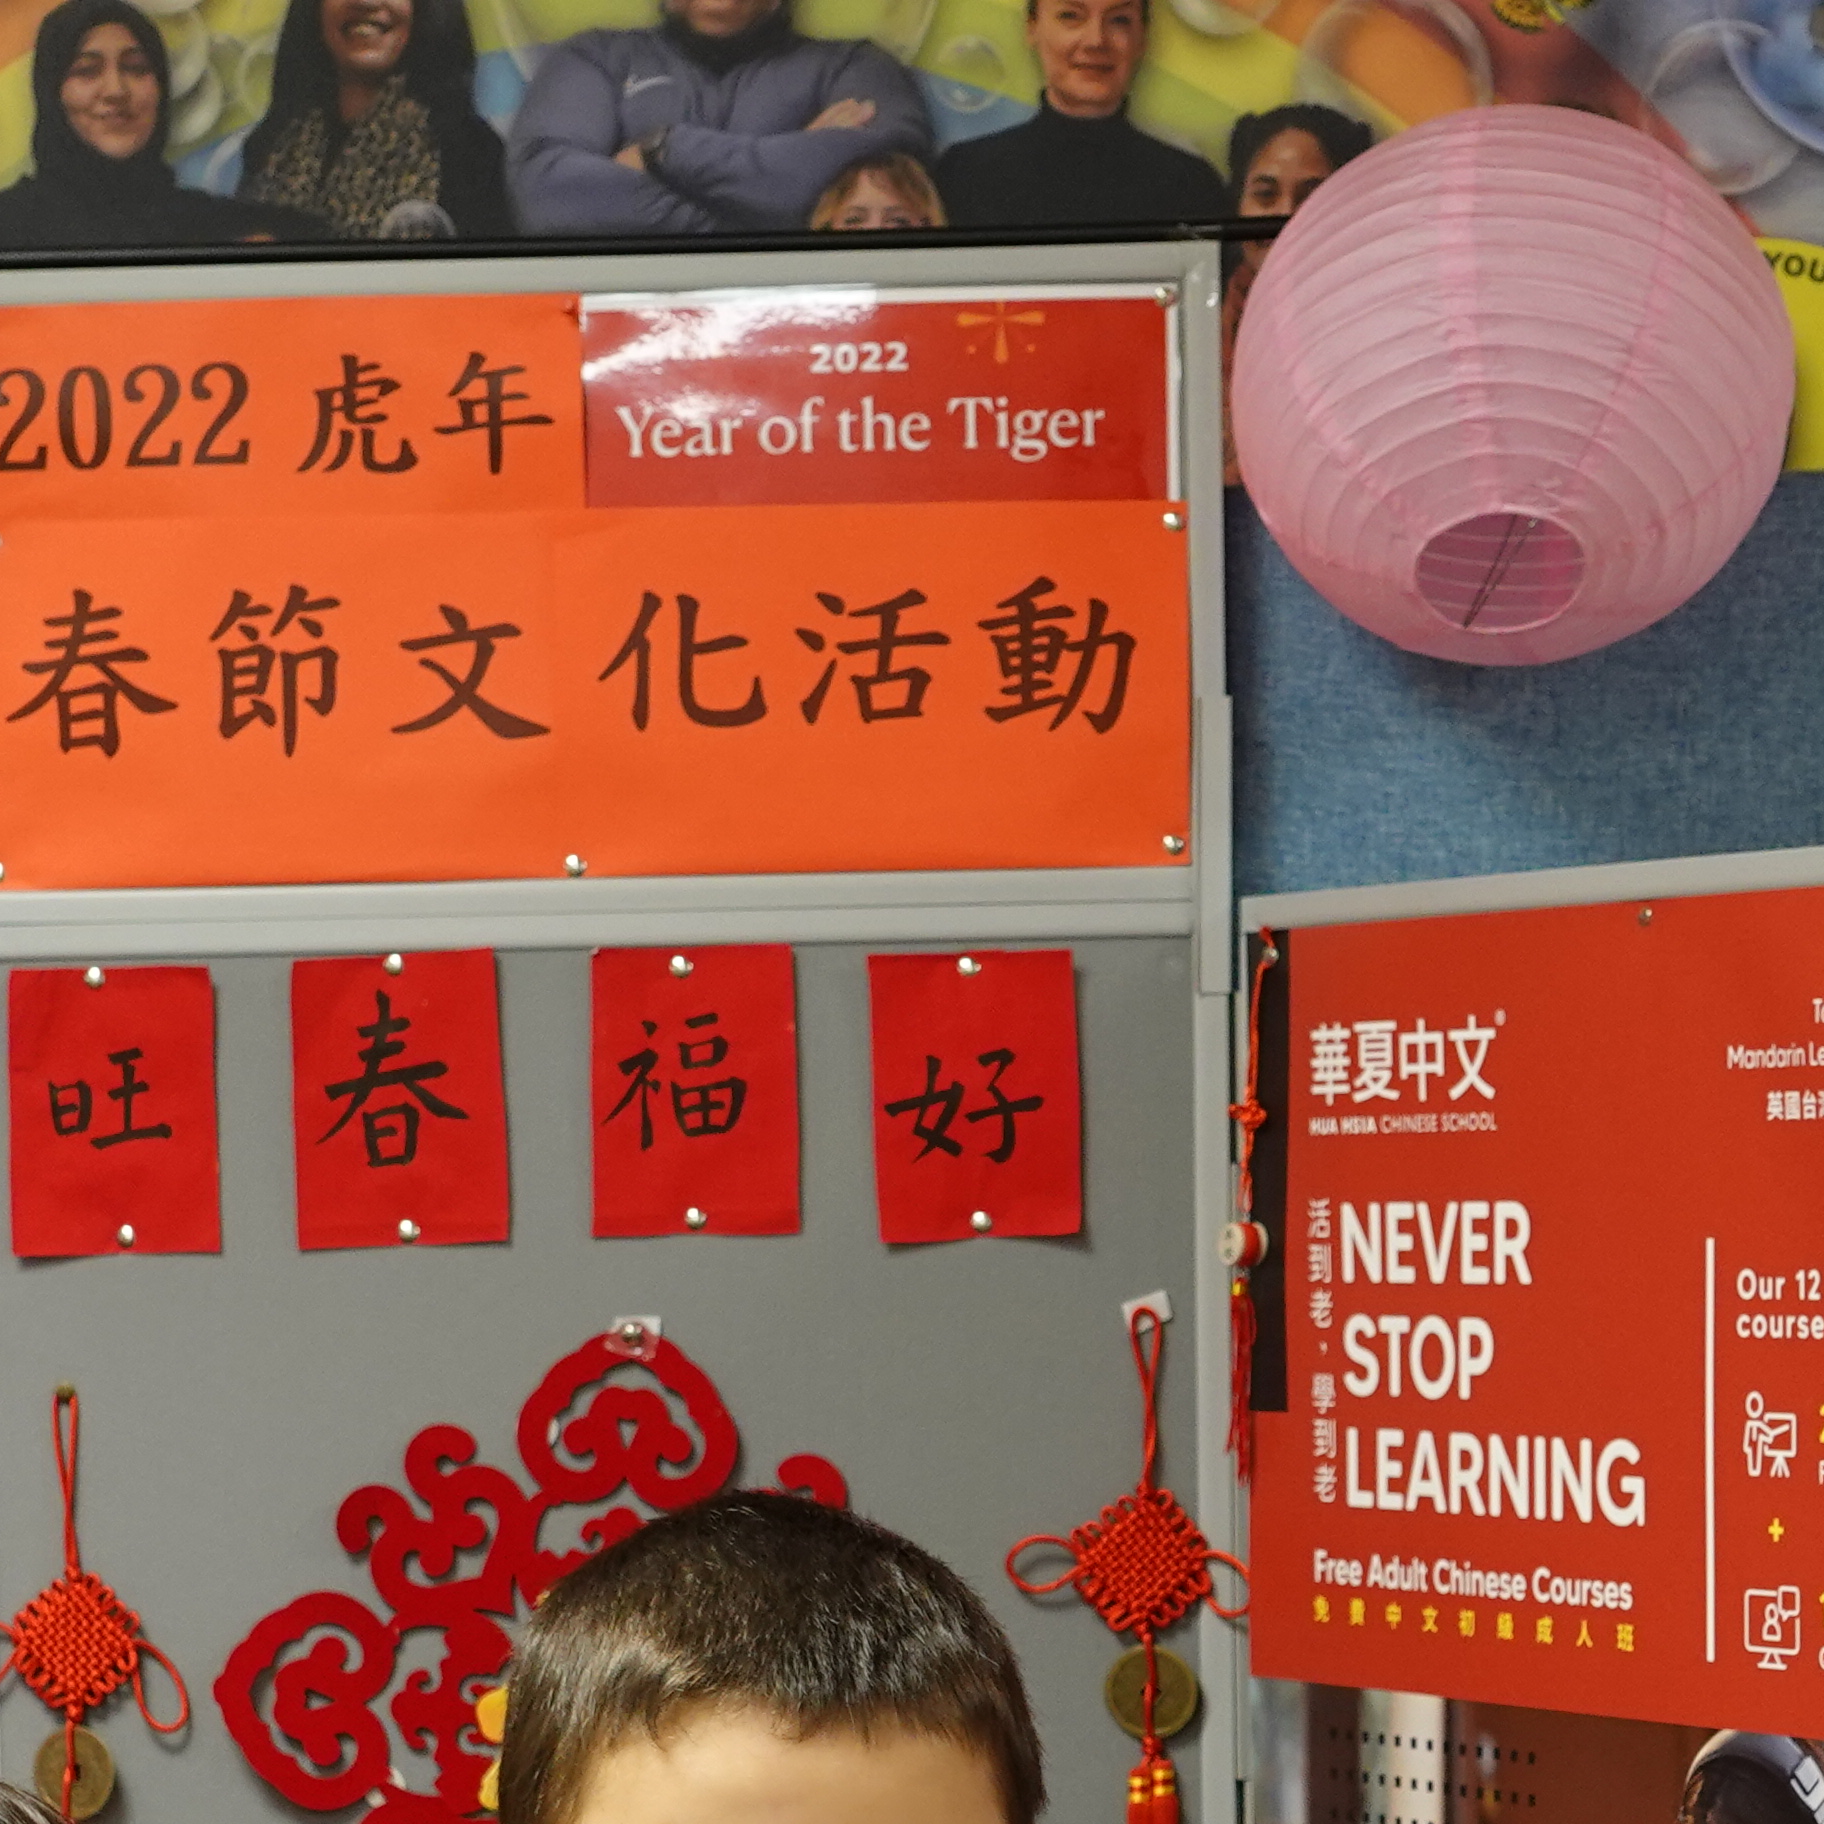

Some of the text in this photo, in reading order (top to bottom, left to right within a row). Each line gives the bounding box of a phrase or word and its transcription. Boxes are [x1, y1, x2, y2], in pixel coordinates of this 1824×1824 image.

[809, 341, 909, 373] 2022
[295, 350, 554, 476] 虎年
[615, 396, 1105, 463] Year of the Tiger
[5, 576, 1136, 760] 春節文化活動
[49, 1047, 172, 1151] 旺
[316, 990, 470, 1169] 春
[601, 1012, 748, 1150] 福
[1310, 1013, 1496, 1106] 華夏中文
[1727, 1044, 1806, 1070] Mandarin
[883, 1047, 1044, 1164] 好
[1309, 1111, 1498, 1136] HUA HSIA CHINESE SCHOOL
[1341, 1200, 1532, 1285] NEVER
[1737, 1269, 1784, 1301] Our
[1795, 1270, 1821, 1300] 12
[1343, 1313, 1495, 1401] STOP
[1736, 1314, 1824, 1339] course
[1345, 1427, 1645, 1528] LEARNING
[1313, 1549, 1633, 1610] Free Adult Chinese Courses
